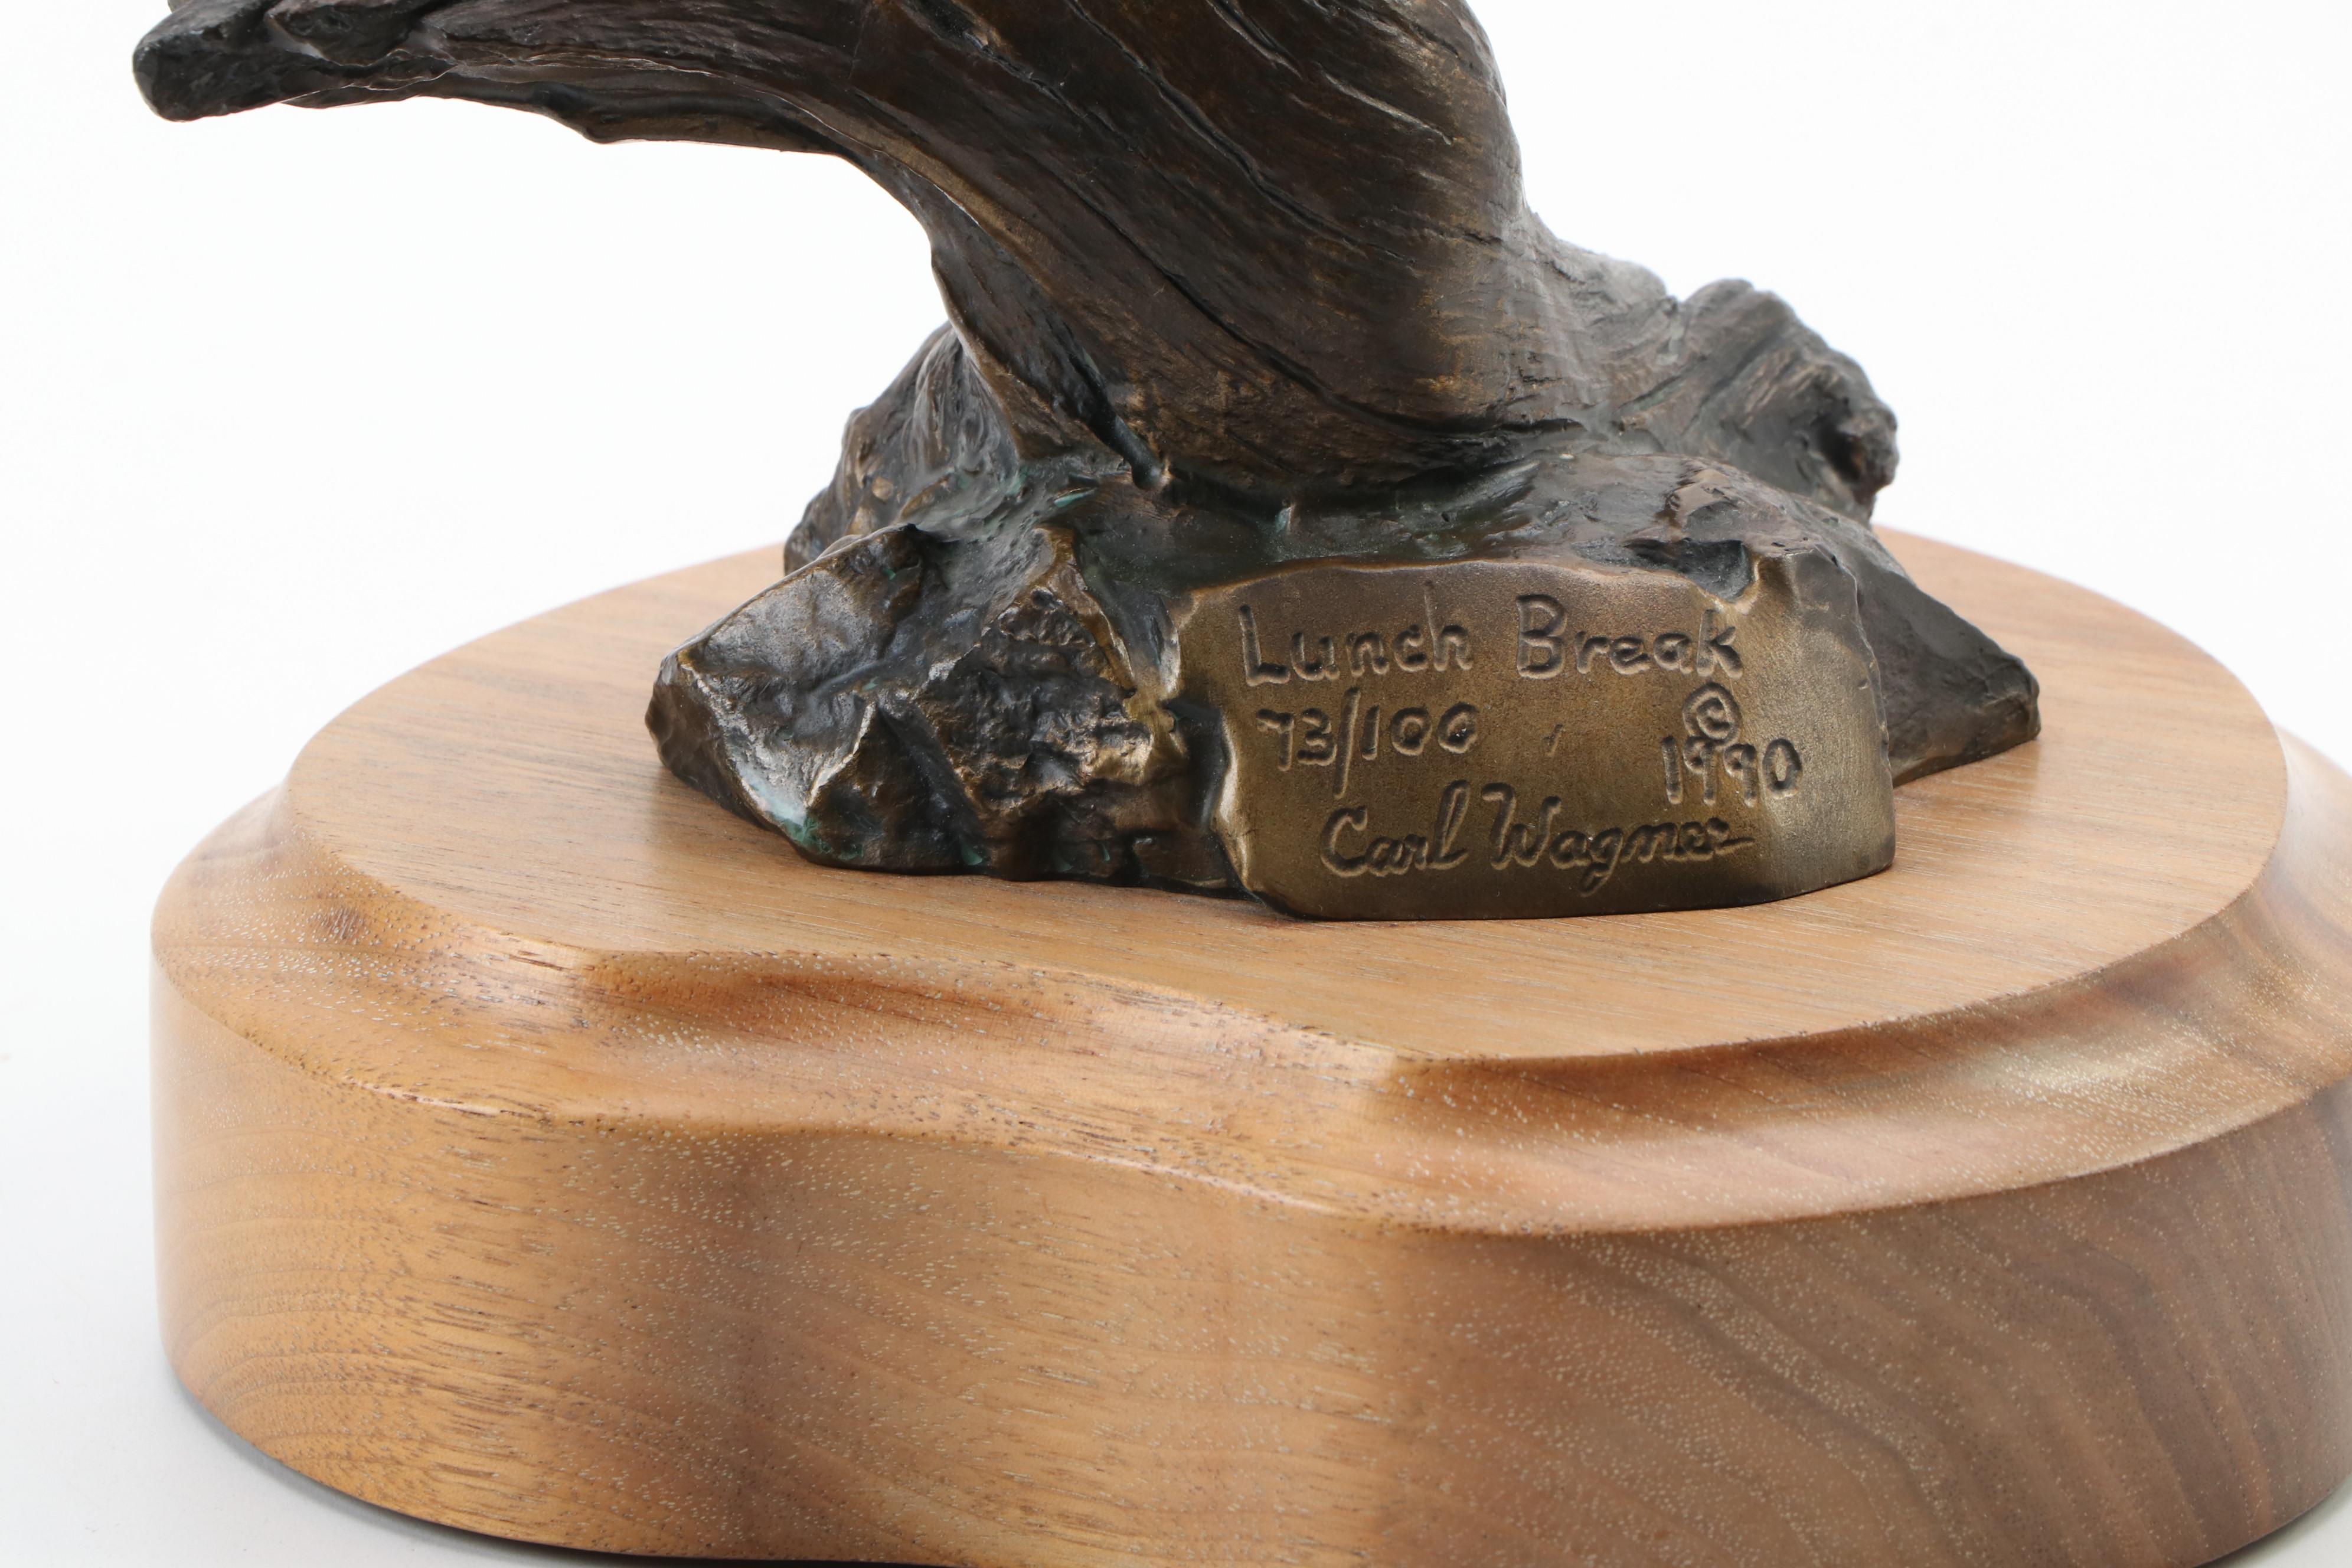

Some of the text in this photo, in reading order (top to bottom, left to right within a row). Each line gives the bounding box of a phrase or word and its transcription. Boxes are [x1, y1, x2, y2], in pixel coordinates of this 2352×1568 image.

[1239, 582, 1743, 686] Lunch Break
[1256, 687, 1479, 798] 73/100
[1662, 736, 1803, 807] 1990
[1321, 780, 1470, 877] Carl
